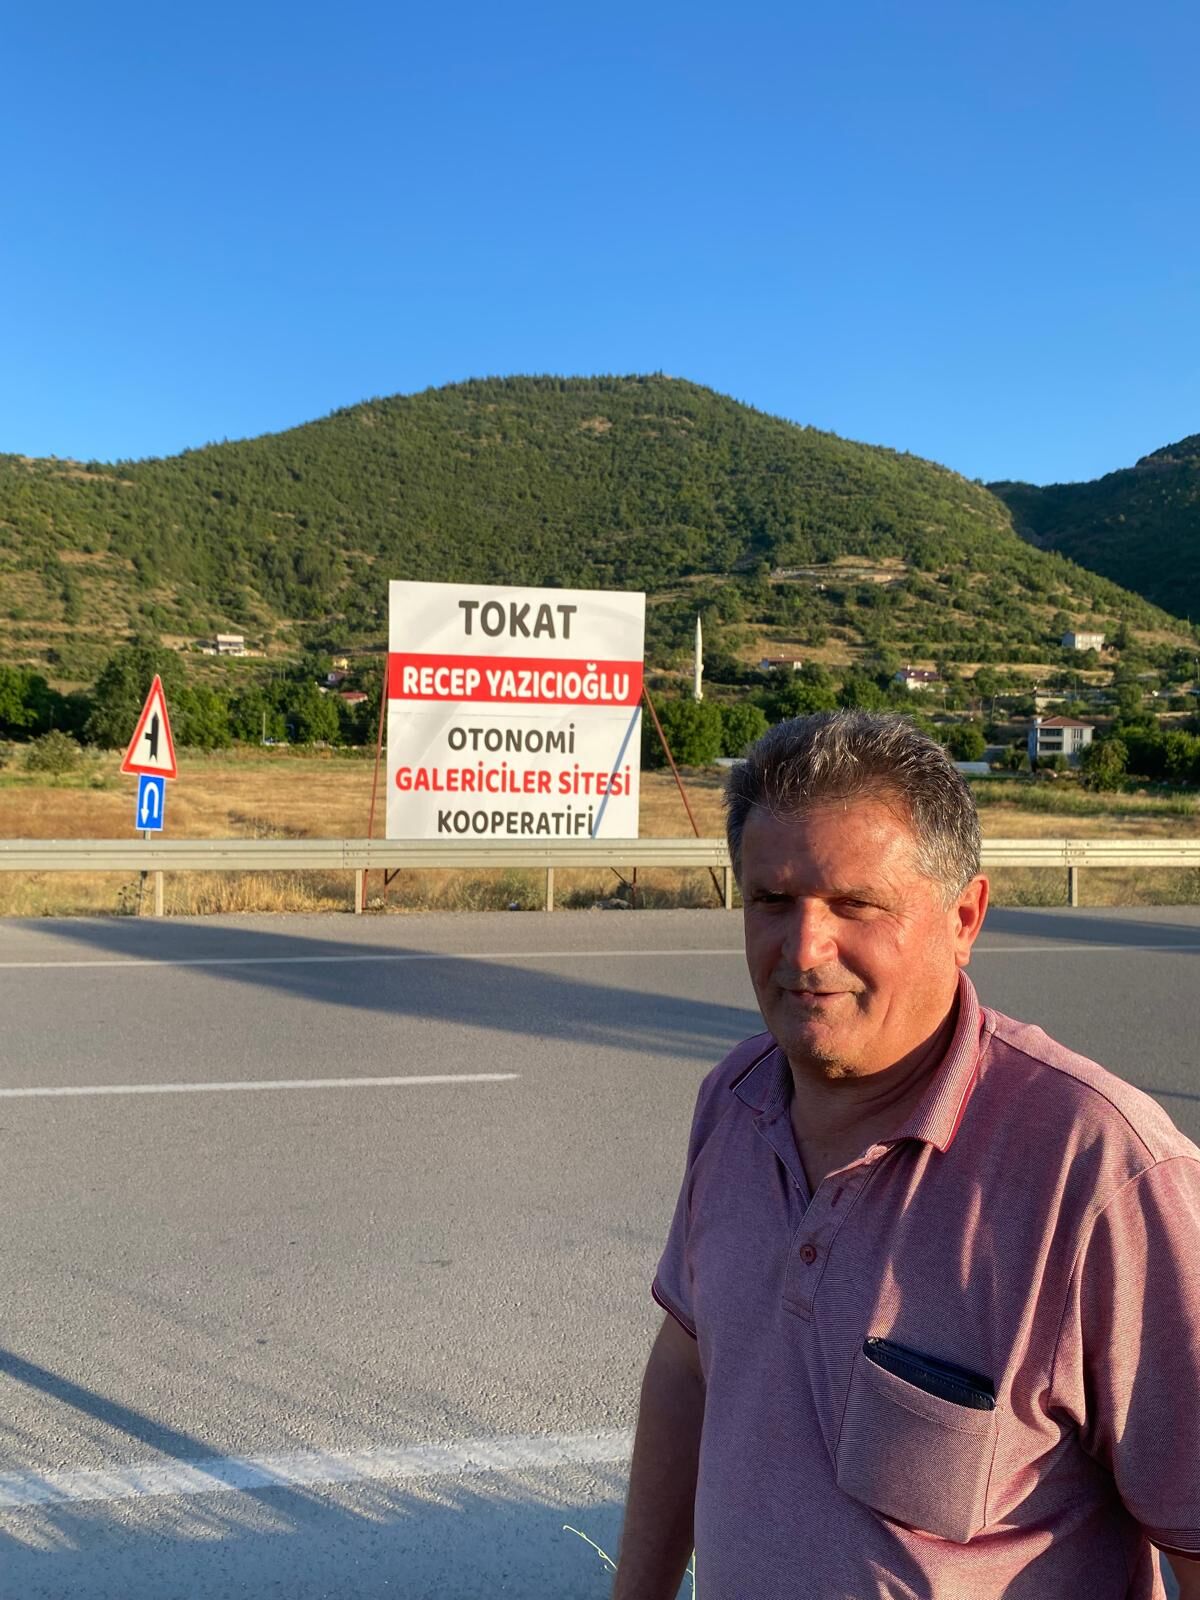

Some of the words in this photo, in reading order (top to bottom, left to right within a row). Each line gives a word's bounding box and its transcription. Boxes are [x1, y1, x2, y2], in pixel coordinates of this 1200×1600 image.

[459, 600, 577, 639] TOKAT
[403, 666, 481, 696] RECEP
[486, 663, 629, 701] YAZICIOĞLU
[448, 723, 575, 754] OTONOMİ
[395, 761, 552, 794] GALERİCİLER
[558, 764, 630, 796] SİTESİ
[438, 805, 594, 836] KOOPERATİFİ
